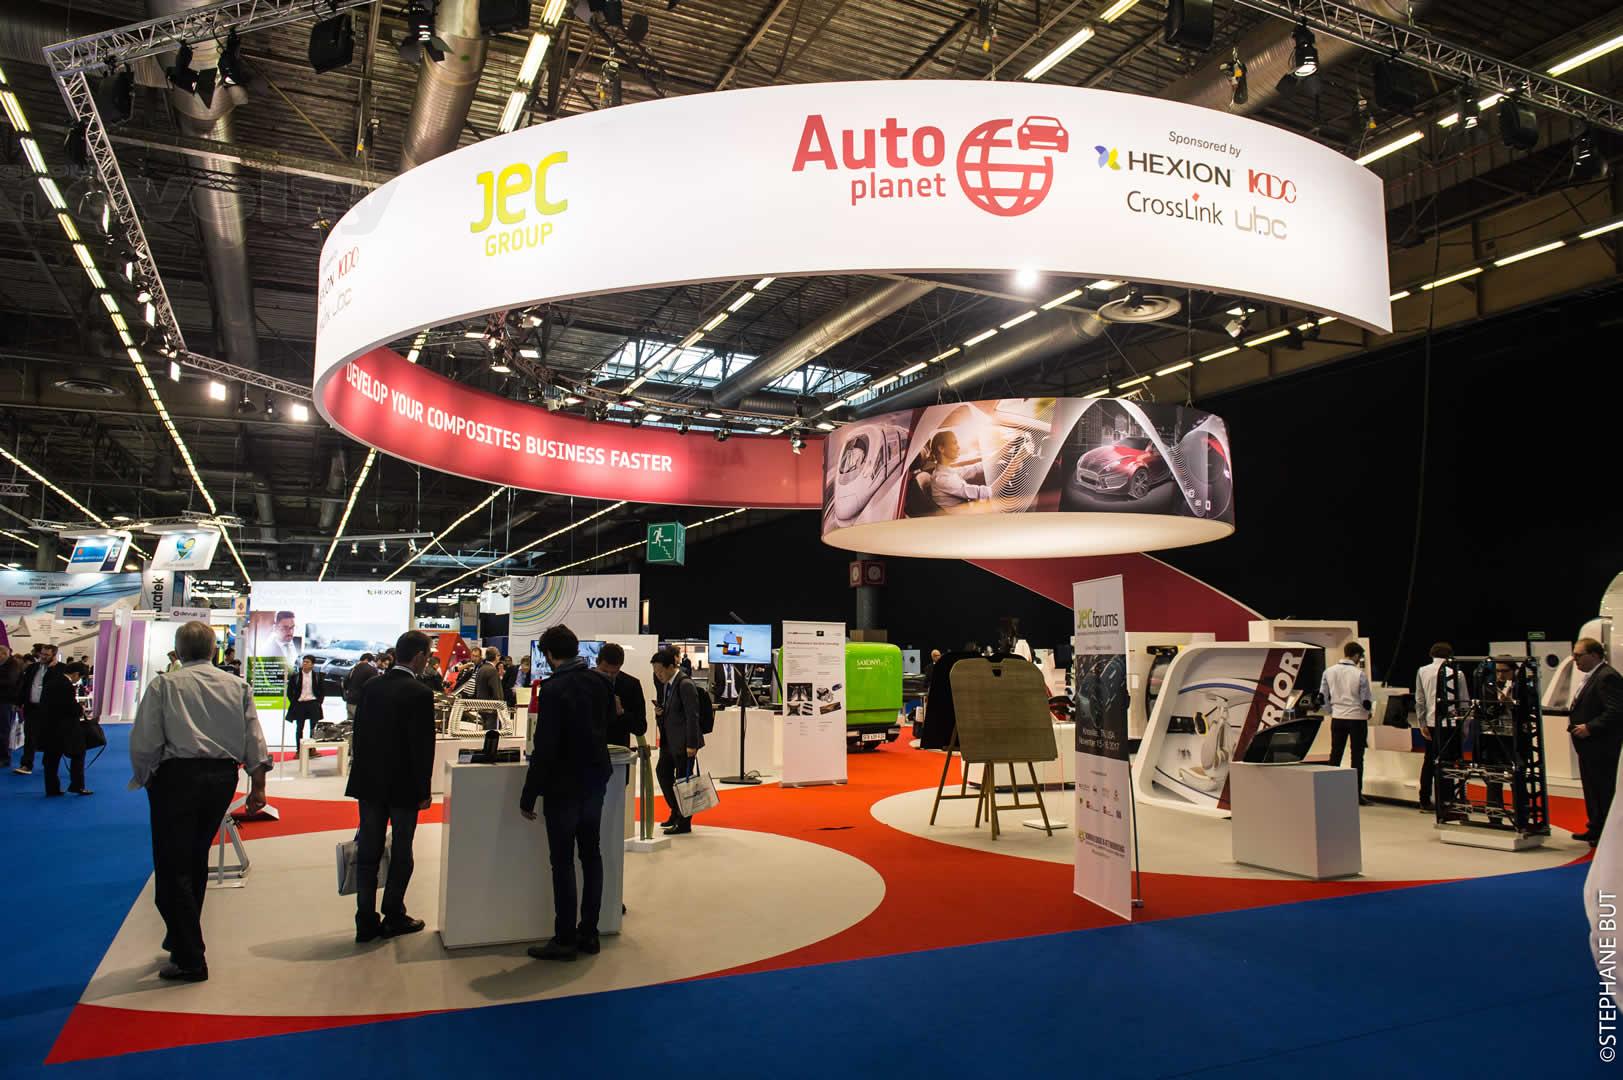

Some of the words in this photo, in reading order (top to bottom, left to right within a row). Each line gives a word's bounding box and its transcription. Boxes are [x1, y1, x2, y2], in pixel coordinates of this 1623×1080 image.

[792, 114, 945, 171] Auto
[1168, 130, 1226, 153] Sponsored
[1229, 145, 1241, 157] by
[1128, 151, 1231, 187] HEXION
[851, 172, 946, 206] planet
[1127, 191, 1223, 225] CrossLink
[485, 223, 554, 257] GROUP
[346, 362, 388, 405] DEVELOP
[391, 389, 424, 424] YOUR
[427, 407, 521, 451] COMPOSITES
[526, 436, 605, 465] BUSINESS
[610, 450, 673, 472] FASTER
[586, 596, 628, 608] VOITH
